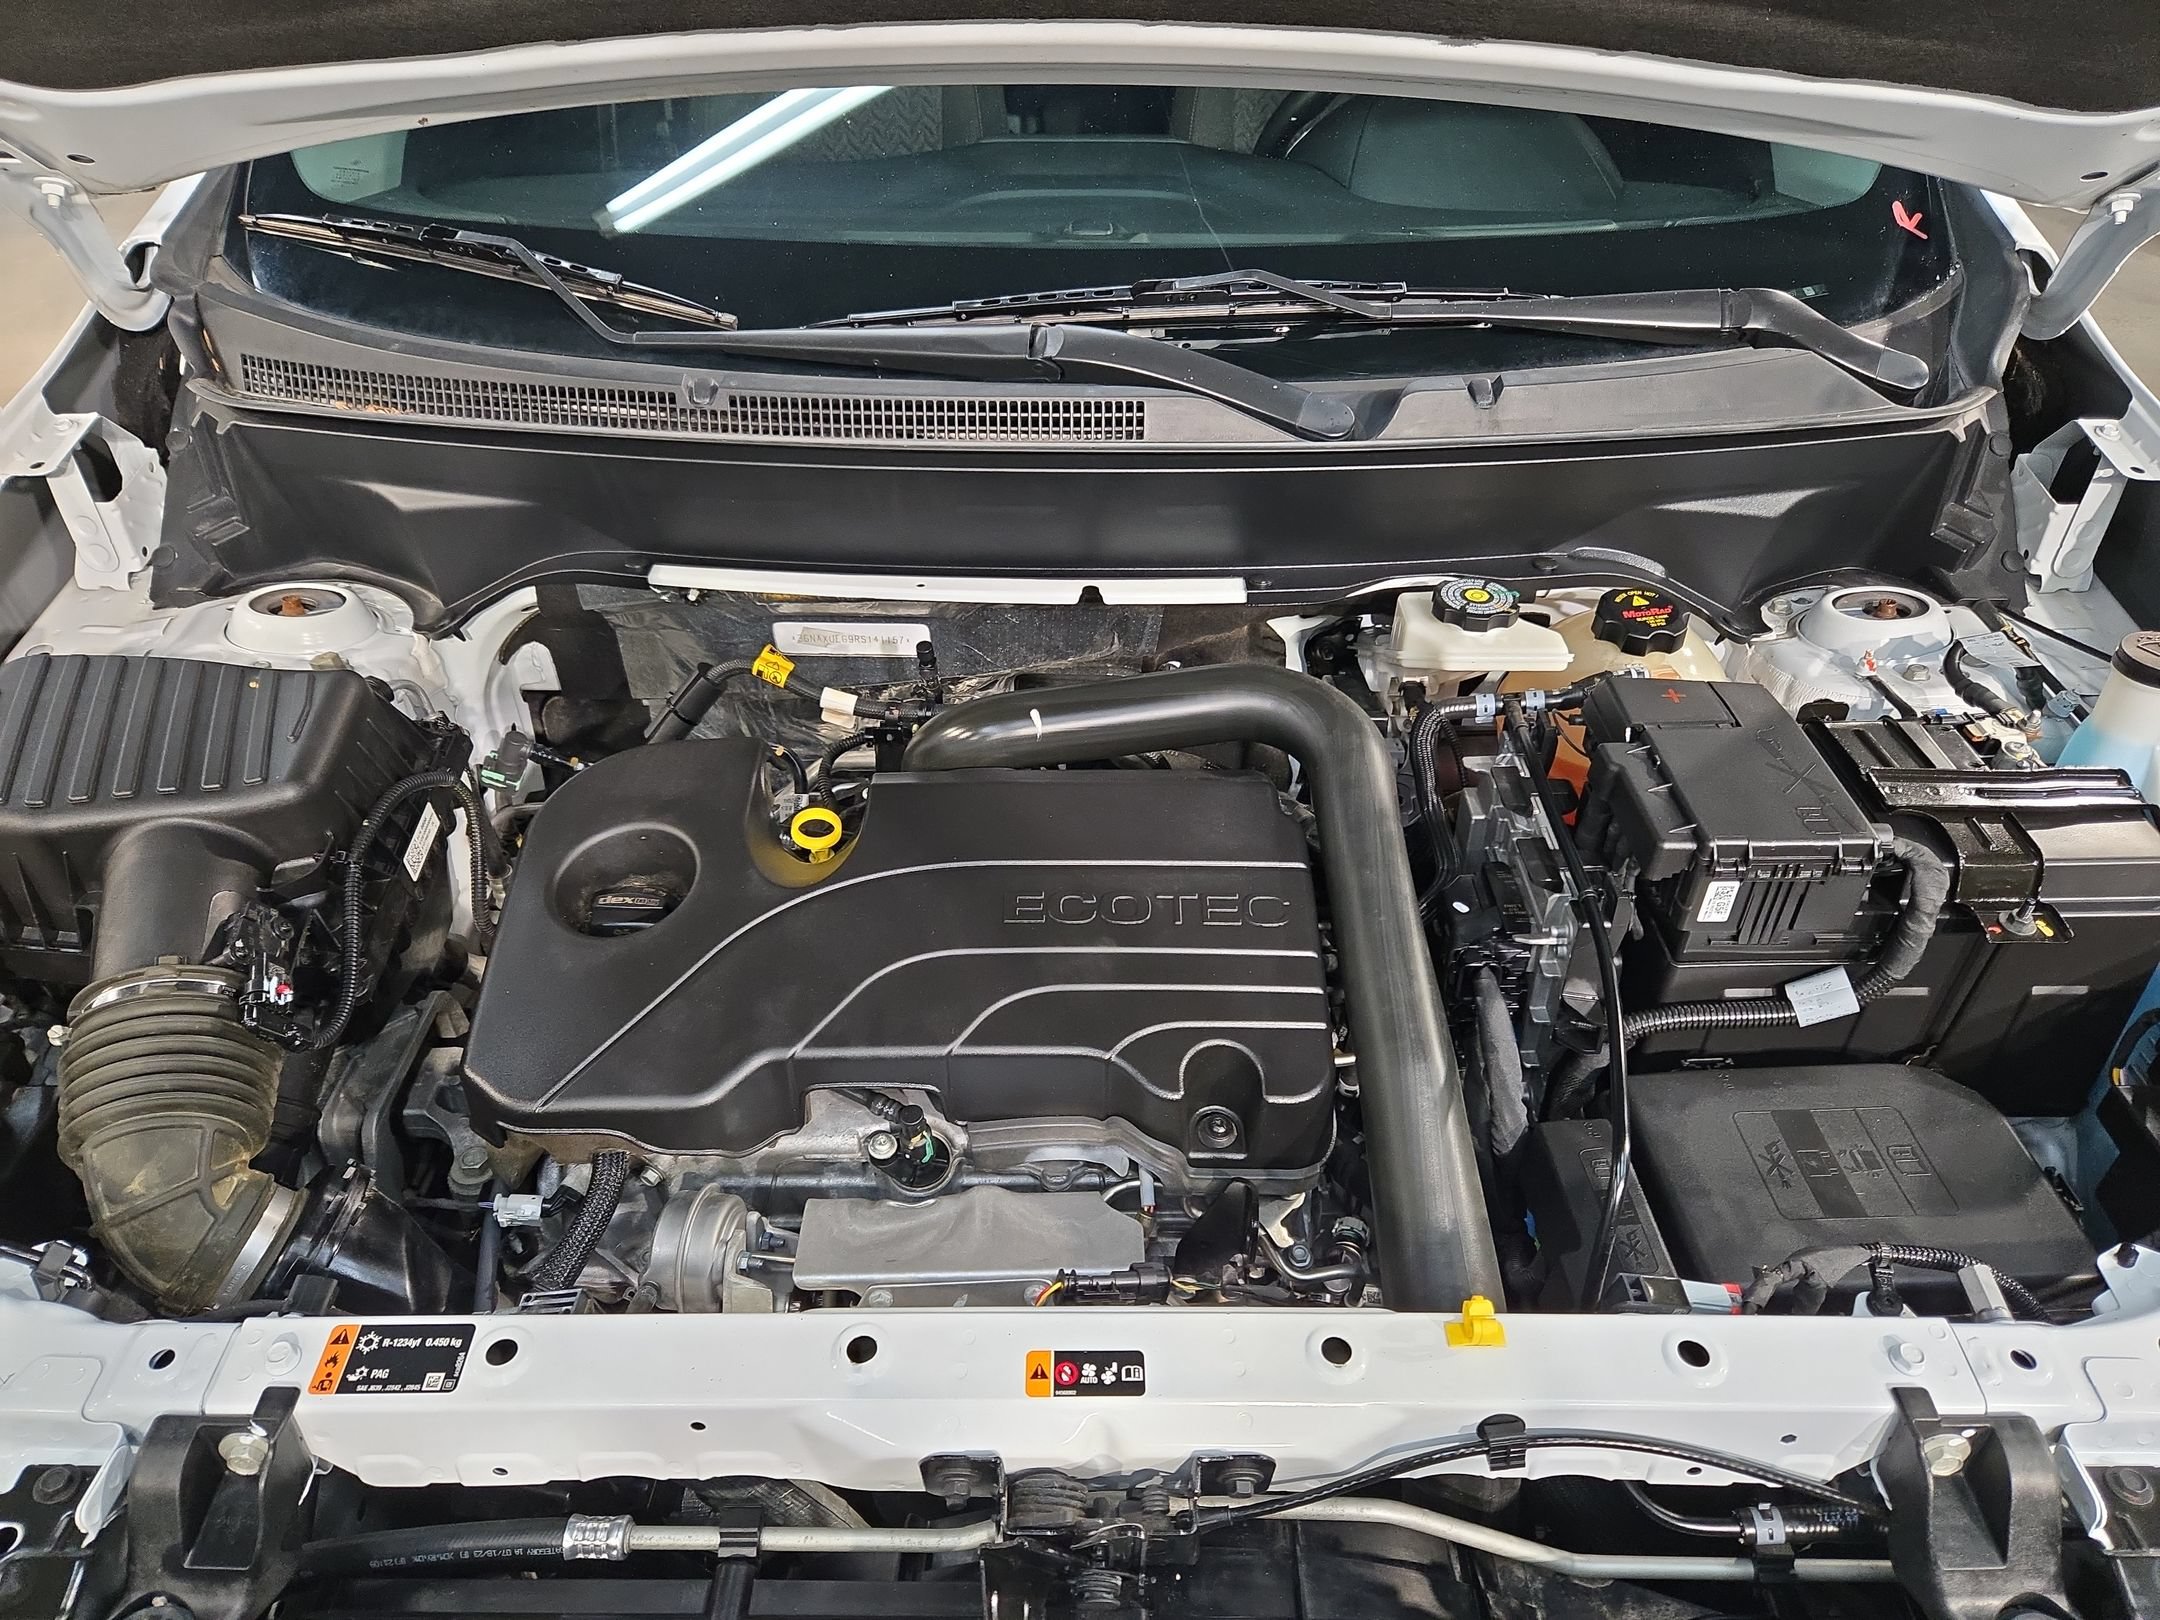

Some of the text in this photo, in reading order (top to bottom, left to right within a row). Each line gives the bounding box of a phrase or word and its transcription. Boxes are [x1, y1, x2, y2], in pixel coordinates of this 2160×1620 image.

[598, 895, 661, 906] dexos
[1002, 889, 1293, 928] ECOTEC
[382, 1337, 463, 1349] R-1234yf 0.450 kg
[370, 1368, 390, 1379] PAG
[1080, 1376, 1098, 1384] AUTO
